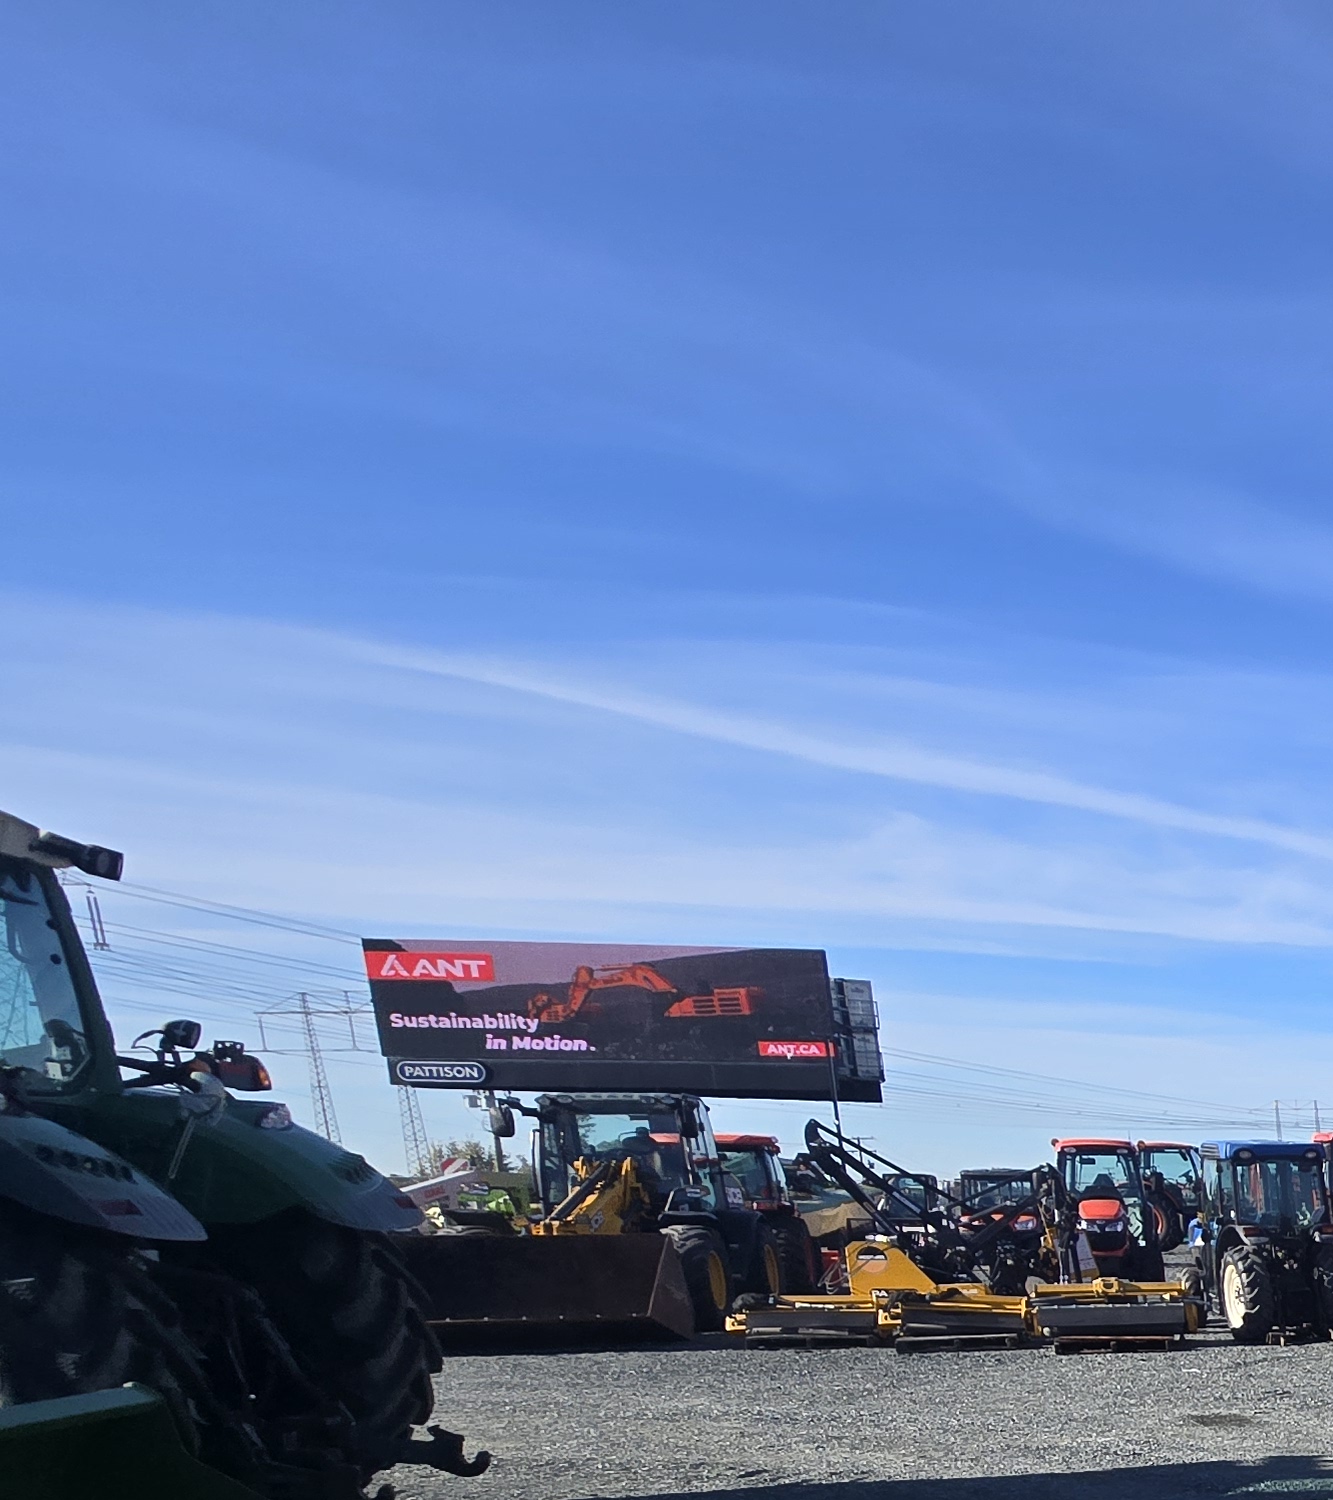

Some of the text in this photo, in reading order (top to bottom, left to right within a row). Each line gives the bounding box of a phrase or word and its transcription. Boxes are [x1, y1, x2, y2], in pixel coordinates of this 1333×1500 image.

[411, 958, 487, 978] ANT
[389, 1012, 540, 1033] Sustainability
[485, 1034, 597, 1051] in Motion.
[767, 1043, 821, 1055] ANT.CA
[404, 1065, 480, 1079] PATTISON
